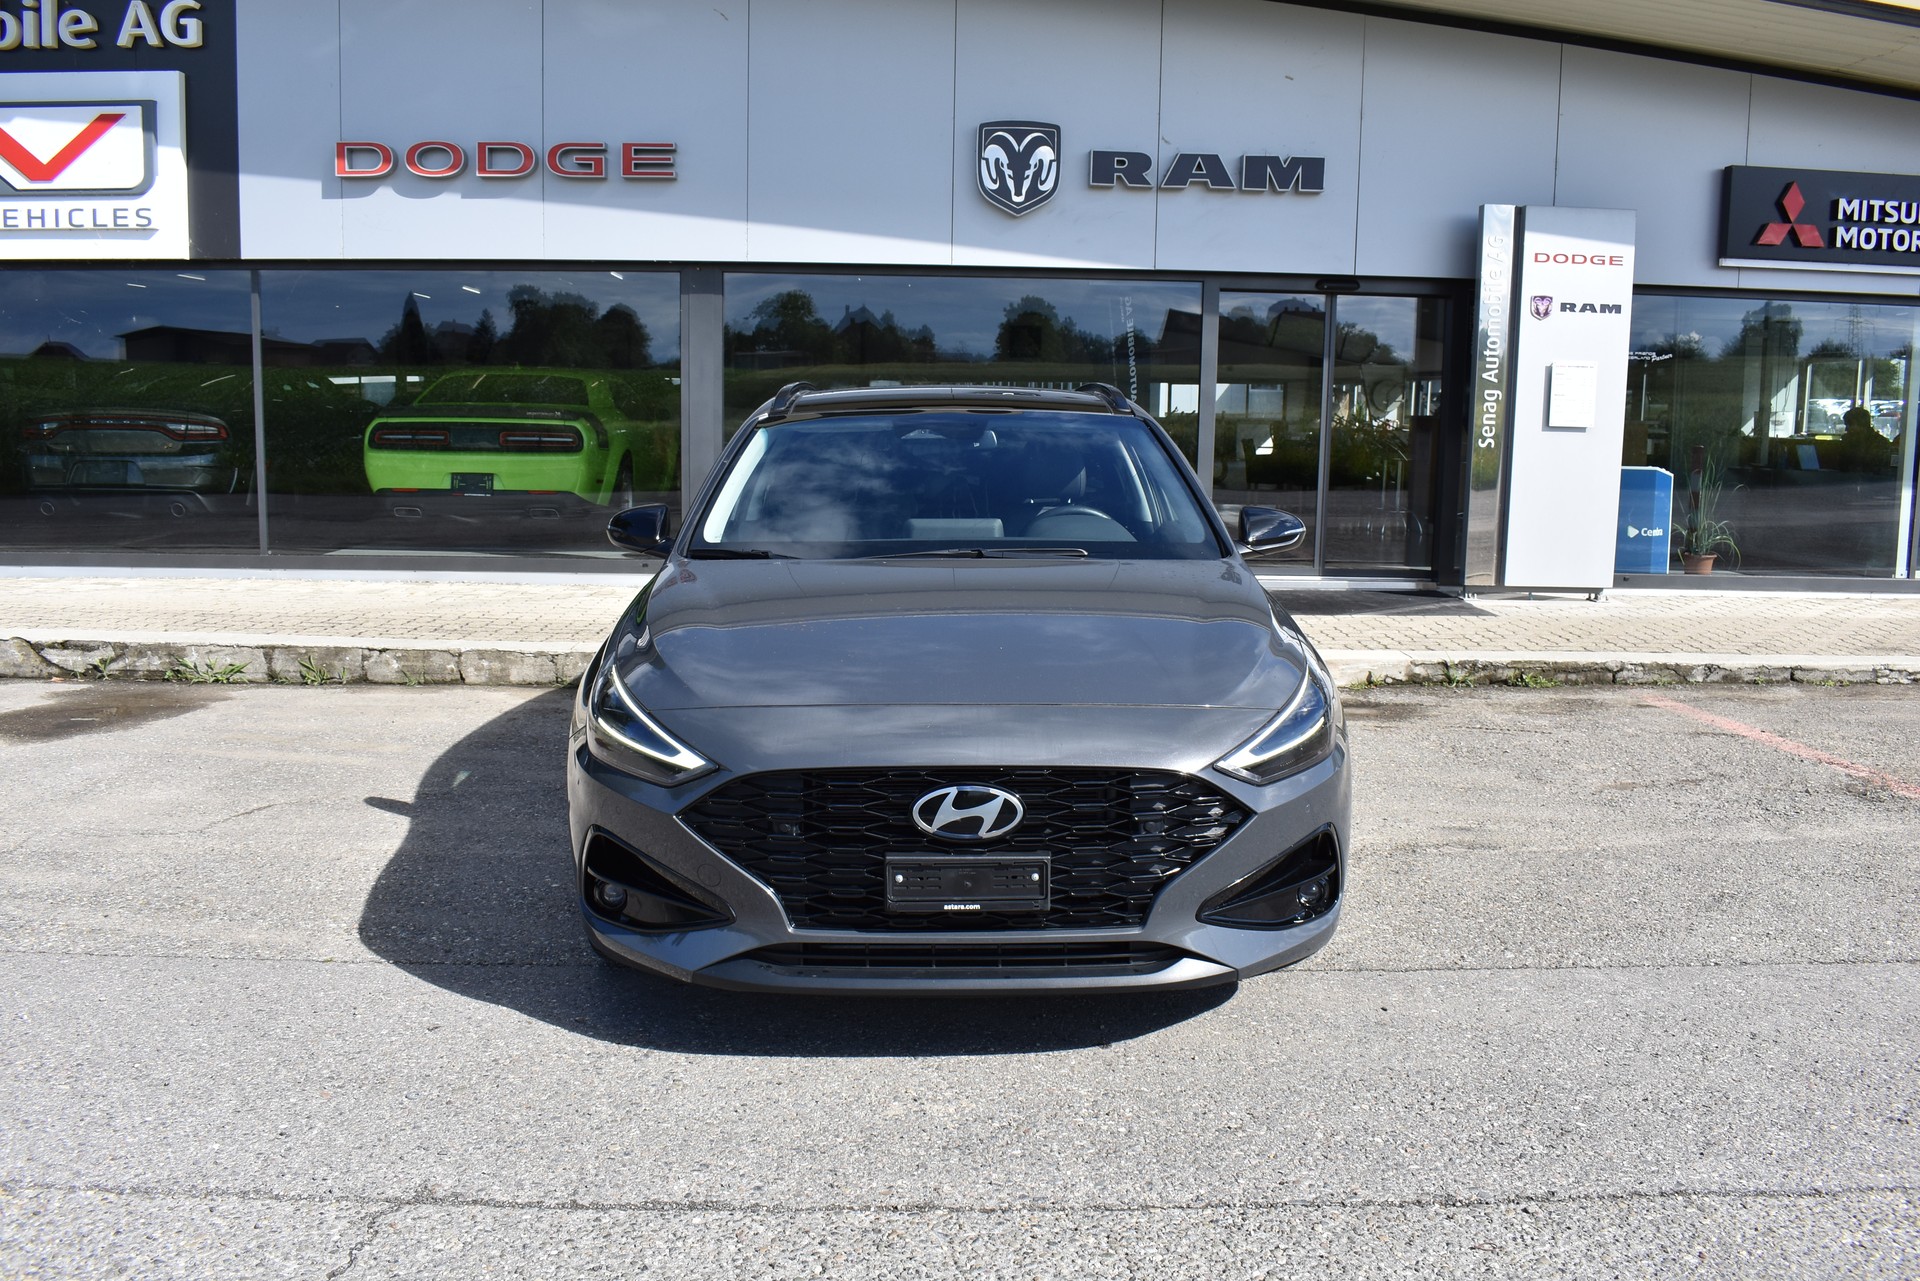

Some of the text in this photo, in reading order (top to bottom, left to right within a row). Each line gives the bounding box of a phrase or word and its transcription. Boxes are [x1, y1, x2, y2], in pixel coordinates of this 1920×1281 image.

[116, 0, 203, 48] AG
[335, 140, 677, 179] DODGE
[1089, 148, 1326, 194] RAM
[1837, 198, 1920, 225] MITSU
[1534, 252, 1624, 266] DODGE
[1560, 302, 1622, 314] RAM
[1478, 235, 1505, 448] Senag Automobile AG
